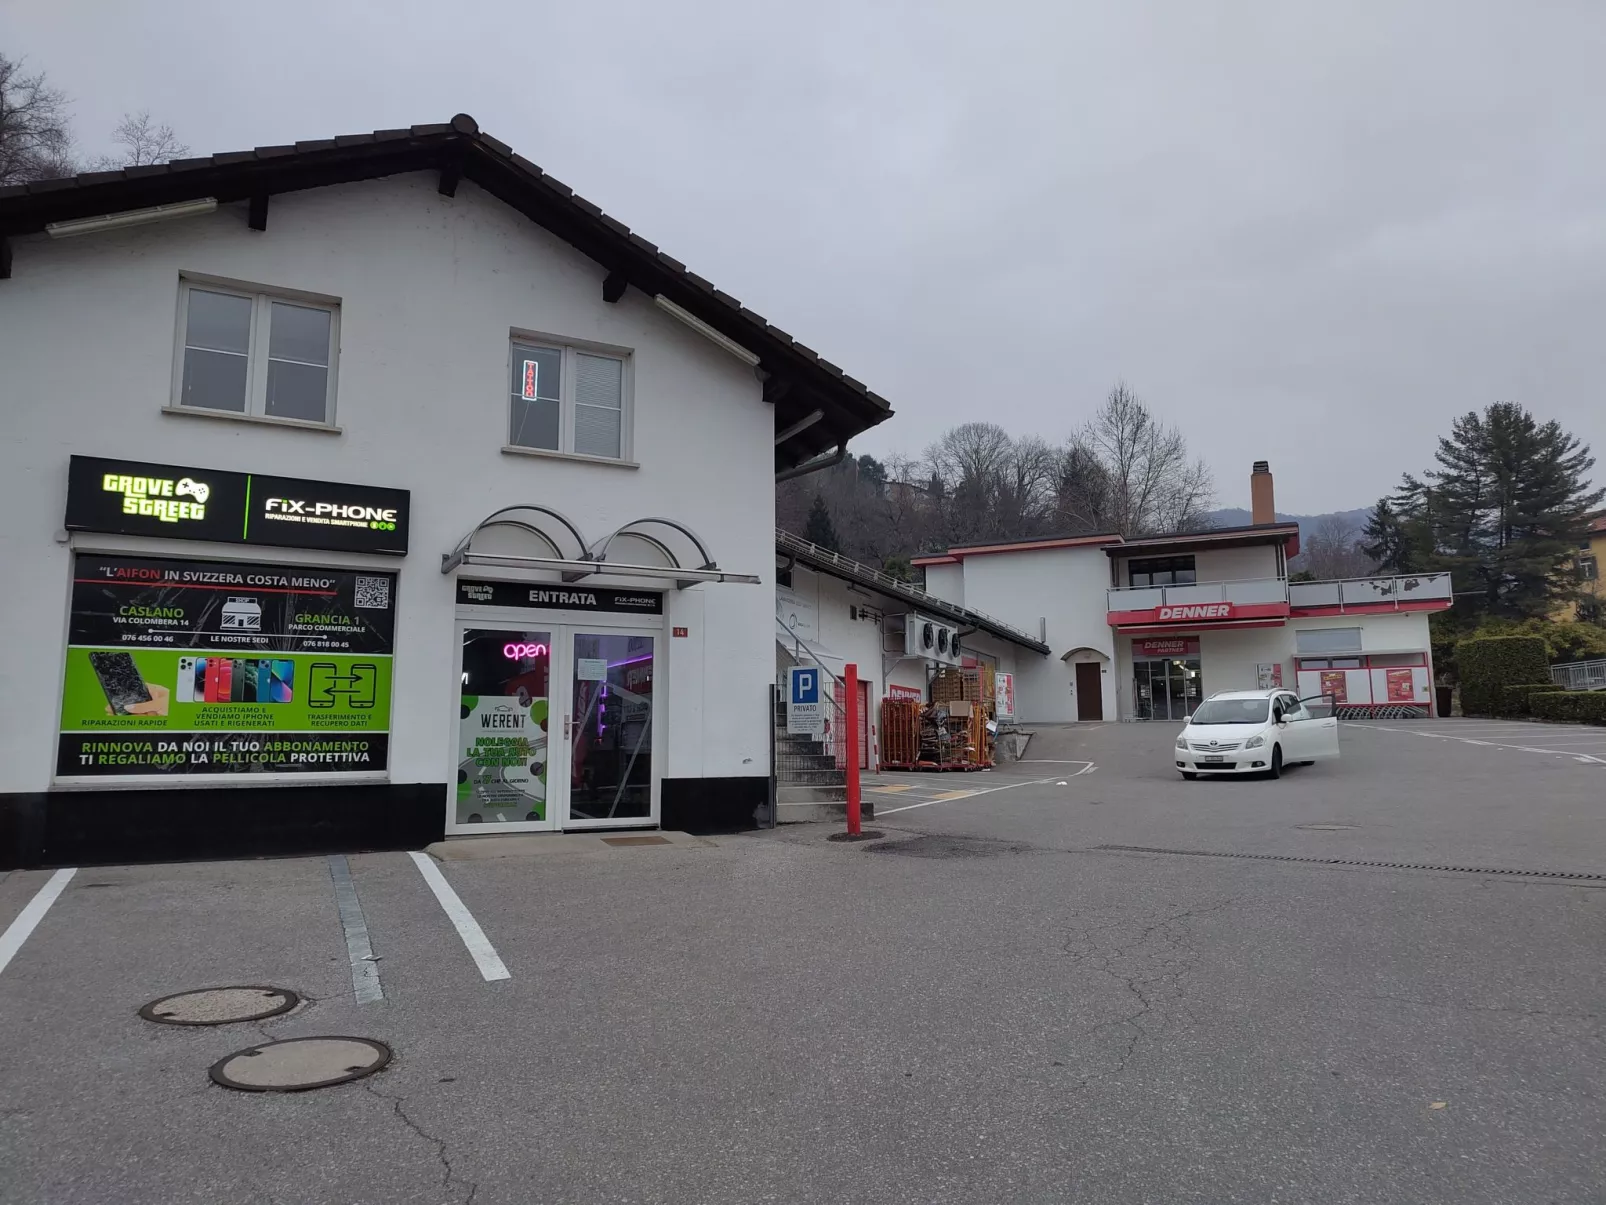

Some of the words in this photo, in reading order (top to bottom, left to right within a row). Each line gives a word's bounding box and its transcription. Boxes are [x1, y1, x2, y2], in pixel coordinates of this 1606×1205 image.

[103, 474, 174, 498] GROVE
[123, 497, 205, 522] STREET
[306, 516, 330, 525] VENDITA
[330, 519, 368, 528] SMARTPHONE
[164, 570, 180, 580] IN
[183, 571, 243, 584] SVIZZERA
[246, 574, 288, 586] COSTA
[529, 590, 597, 606] ENTRATA
[120, 606, 184, 618] CASLANO
[1160, 604, 1230, 620] DENNER
[128, 618, 178, 626] COLOMBERA
[295, 614, 350, 624] GRANCIA
[354, 616, 360, 625] 1
[1144, 640, 1184, 649] DENNER
[800, 674, 812, 699] P
[481, 714, 526, 728] WERENT
[82, 742, 153, 753] RINNOVA
[158, 742, 178, 752] DA
[182, 742, 210, 752] NOI
[214, 742, 227, 752] IL
[231, 741, 260, 752] TUO
[264, 741, 369, 752] ABBONAMENTO
[476, 737, 528, 746] NOLEGGIA
[80, 754, 94, 765] TI
[98, 754, 186, 764] REGALIAMO
[190, 753, 208, 764] LA
[212, 753, 286, 764] PELLICOLA
[290, 752, 370, 762] PROTETTIVA
[466, 748, 480, 758] LA
[476, 758, 500, 767] CON
